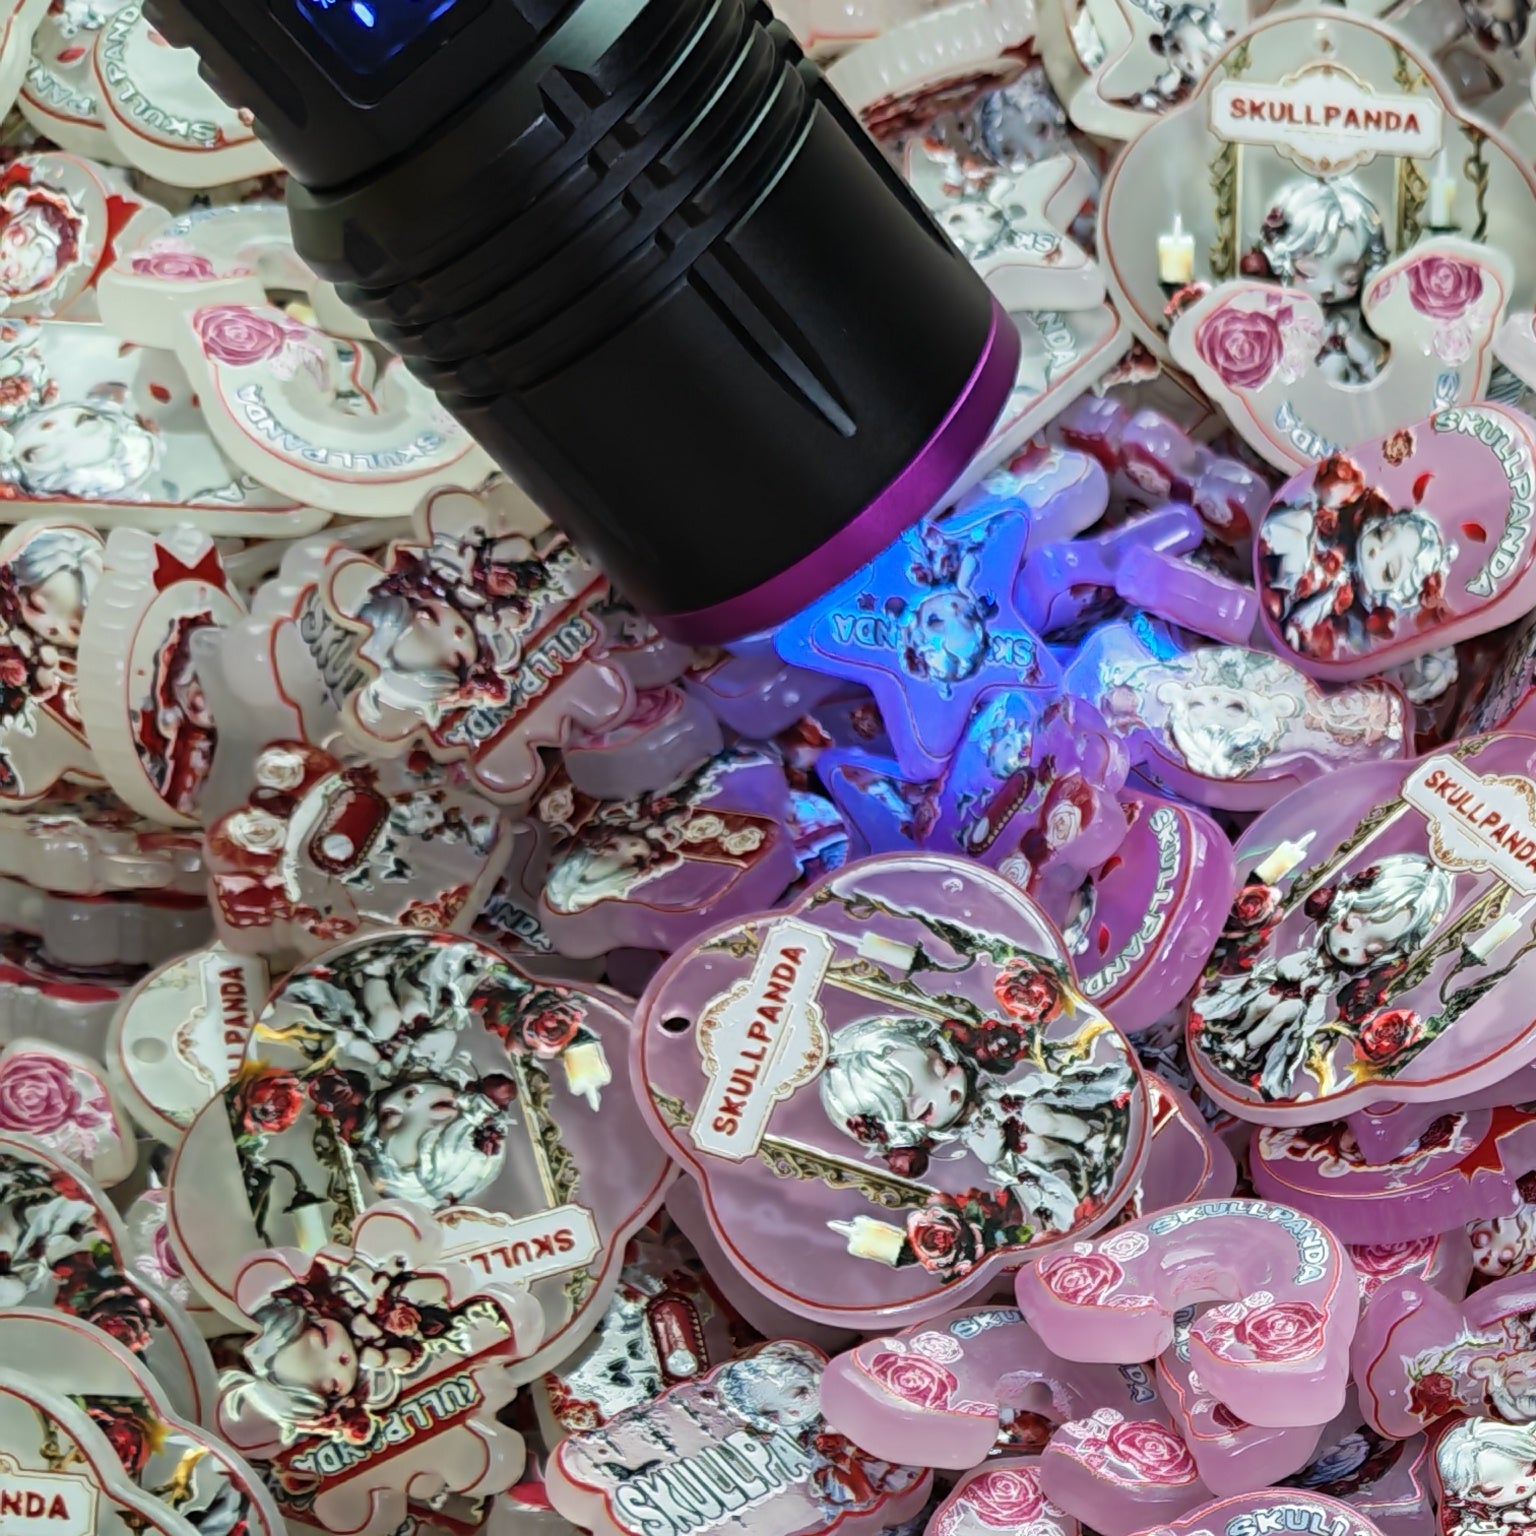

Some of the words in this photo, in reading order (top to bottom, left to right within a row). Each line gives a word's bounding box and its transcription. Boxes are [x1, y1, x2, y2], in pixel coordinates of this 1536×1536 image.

[1229, 97, 1422, 134] SKULLPANDA
[237, 385, 442, 468] SKULLPANDA
[1434, 412, 1533, 596] SKULLPANDA
[713, 945, 806, 1136] SKULLPANDA
[1149, 1199, 1330, 1285] SKULLPANDA
